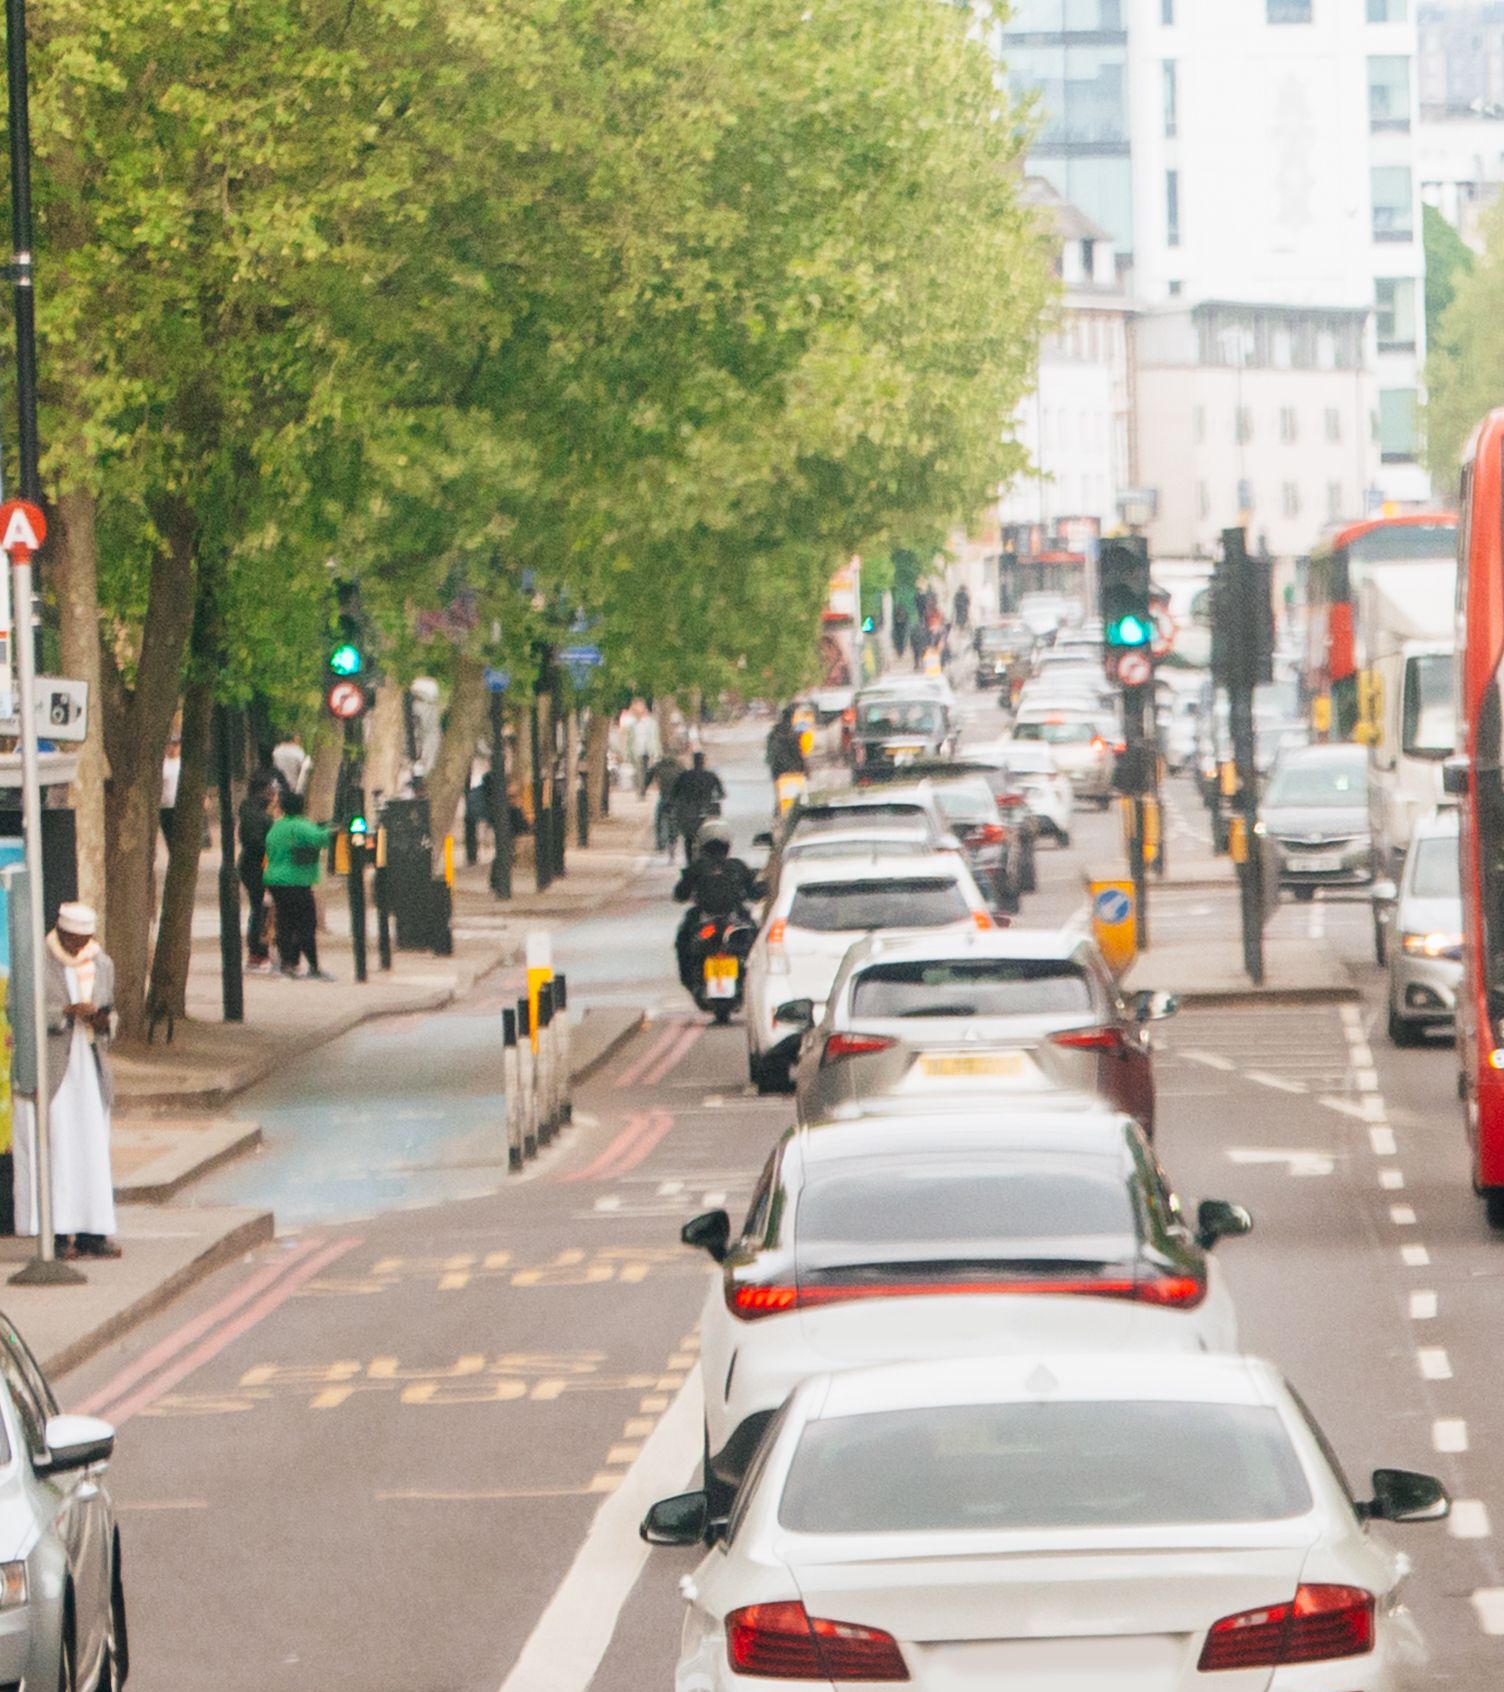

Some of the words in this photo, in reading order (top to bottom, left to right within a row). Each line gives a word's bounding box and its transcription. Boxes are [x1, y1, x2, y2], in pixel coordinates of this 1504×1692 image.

[2, 507, 39, 549] A
[239, 1349, 610, 1386] BUS
[138, 1373, 659, 1418] STOP
